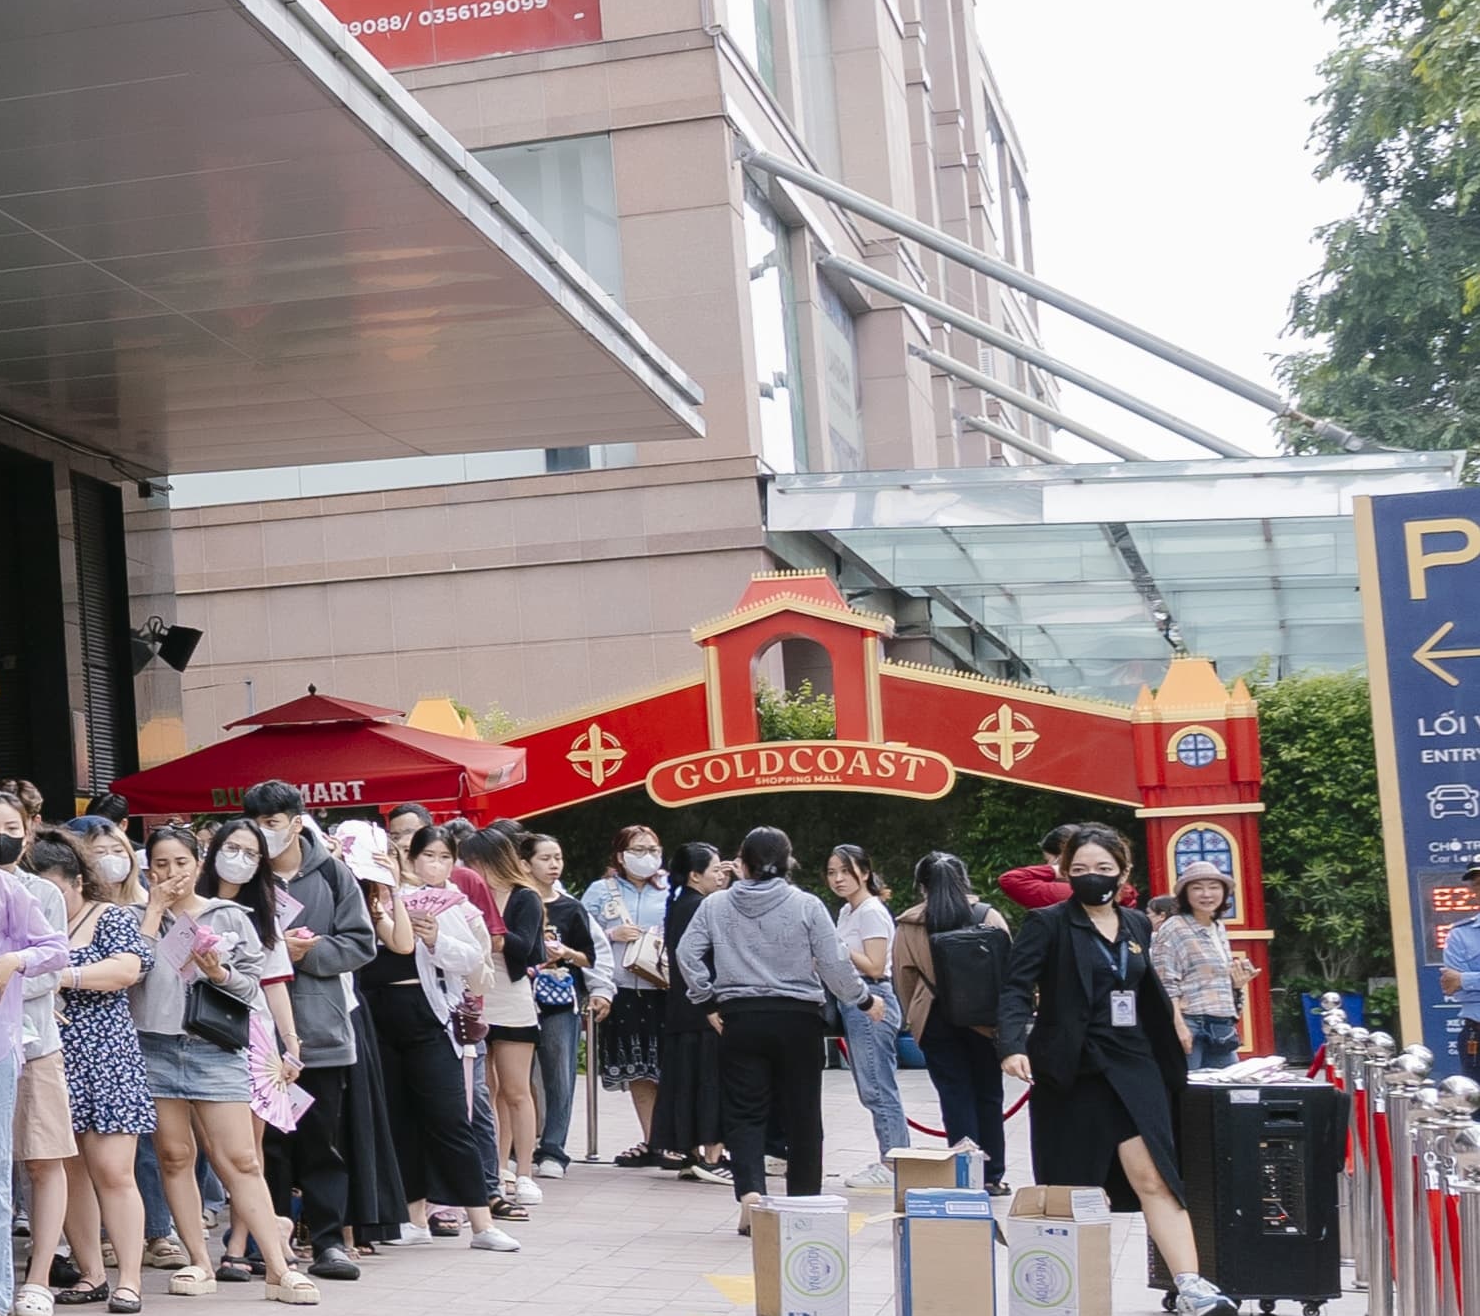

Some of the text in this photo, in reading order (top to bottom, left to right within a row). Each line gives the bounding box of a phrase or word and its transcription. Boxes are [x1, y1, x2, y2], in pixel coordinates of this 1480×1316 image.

[1404, 517, 1480, 601] P
[1418, 710, 1466, 736] LỐI
[673, 747, 926, 790] GOLDCOAST
[755, 774, 842, 785] SHOPPING MALL
[807, 1246, 821, 1292] AQUAFINA
[1034, 1256, 1049, 1304] AQUAFINA
